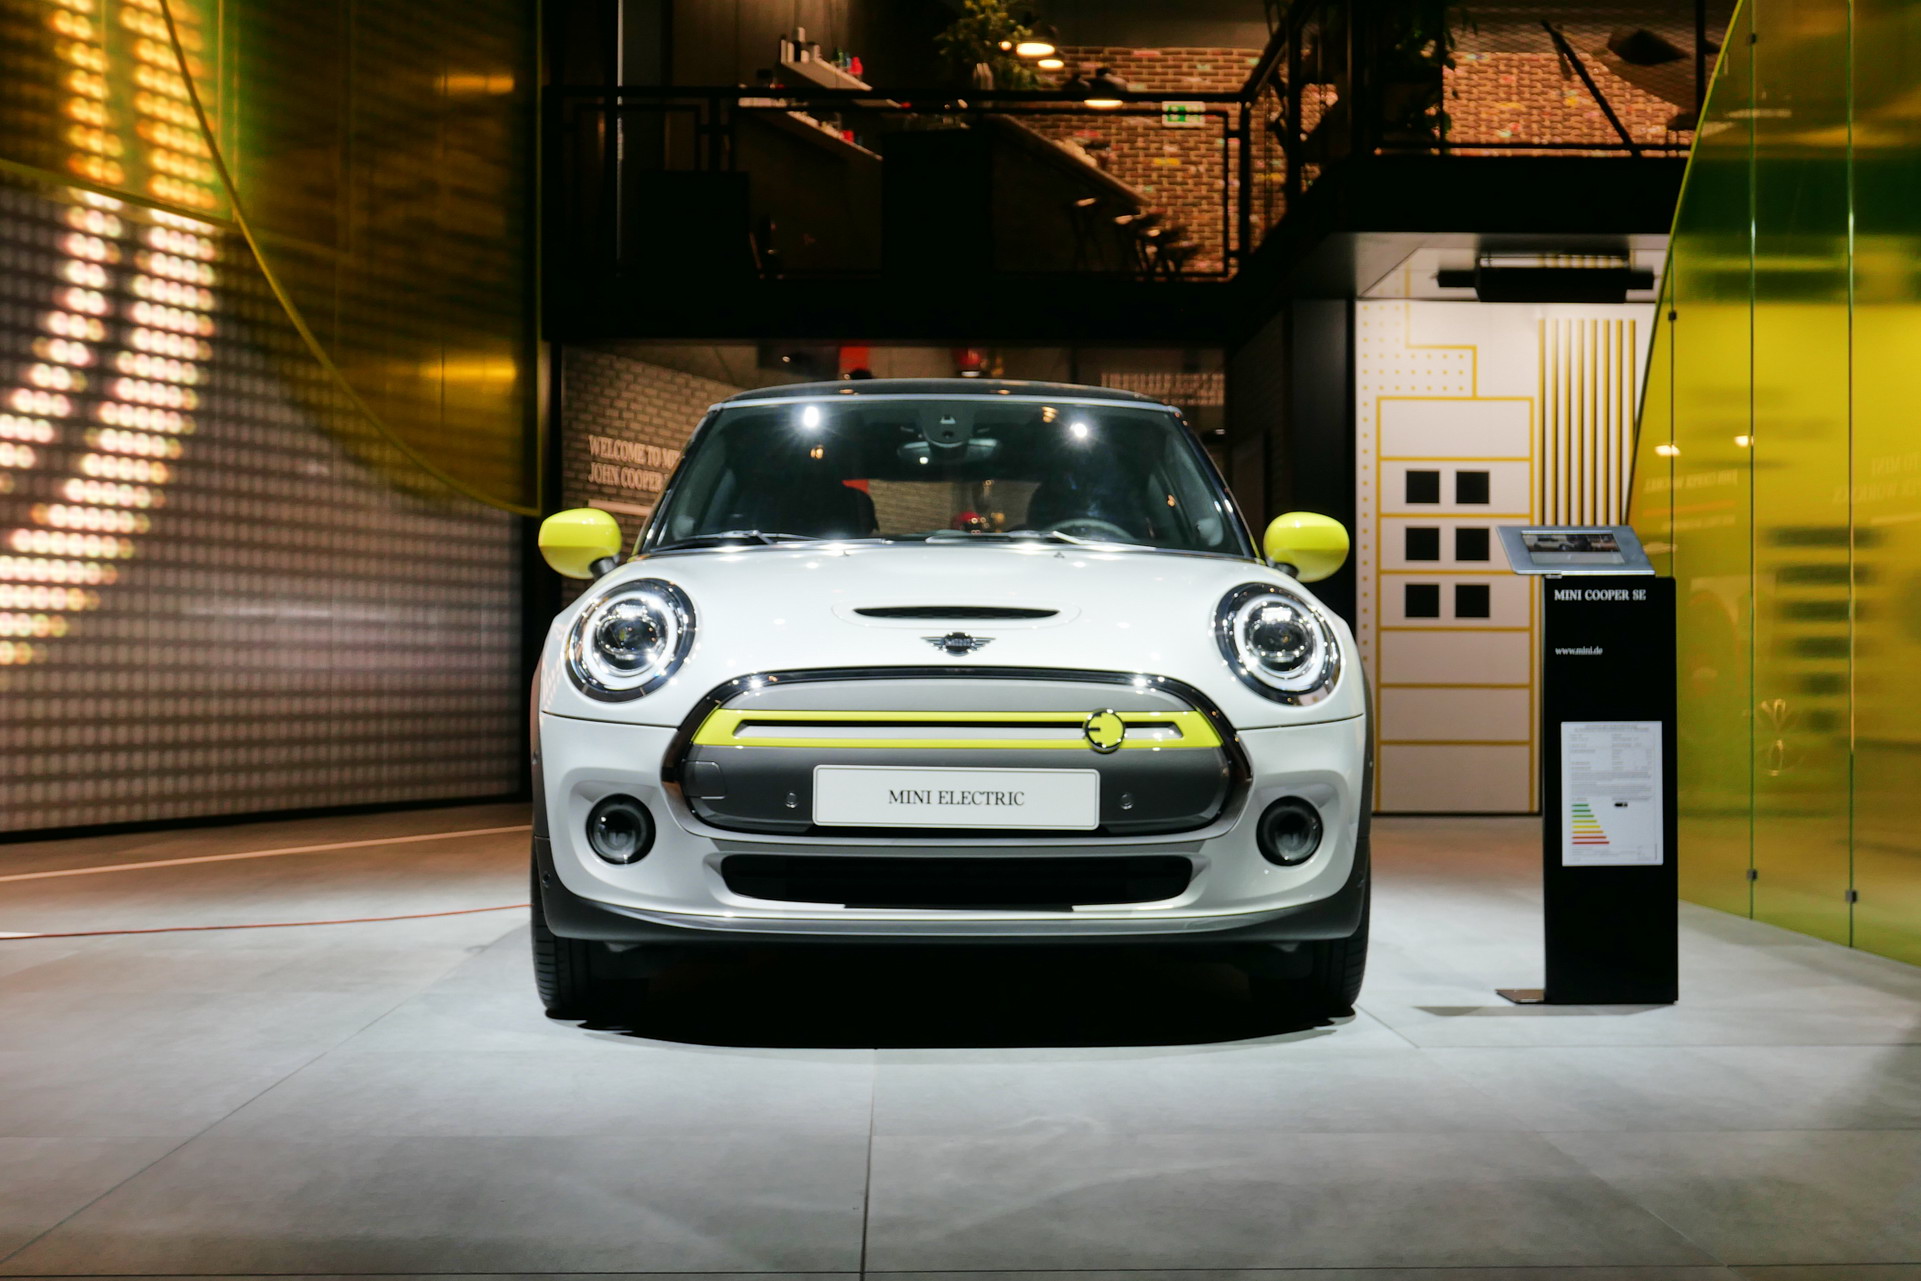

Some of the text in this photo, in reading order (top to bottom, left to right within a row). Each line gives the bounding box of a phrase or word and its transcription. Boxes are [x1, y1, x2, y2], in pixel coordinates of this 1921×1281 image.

[588, 435, 646, 464] WELCOME
[646, 445, 662, 467] TO
[588, 462, 663, 492] JOHN COOPER
[1554, 589, 1646, 601] MINI COOPER SE
[1555, 646, 1603, 656] www.mini.de
[889, 789, 1025, 806] MINI ELECTRIC
